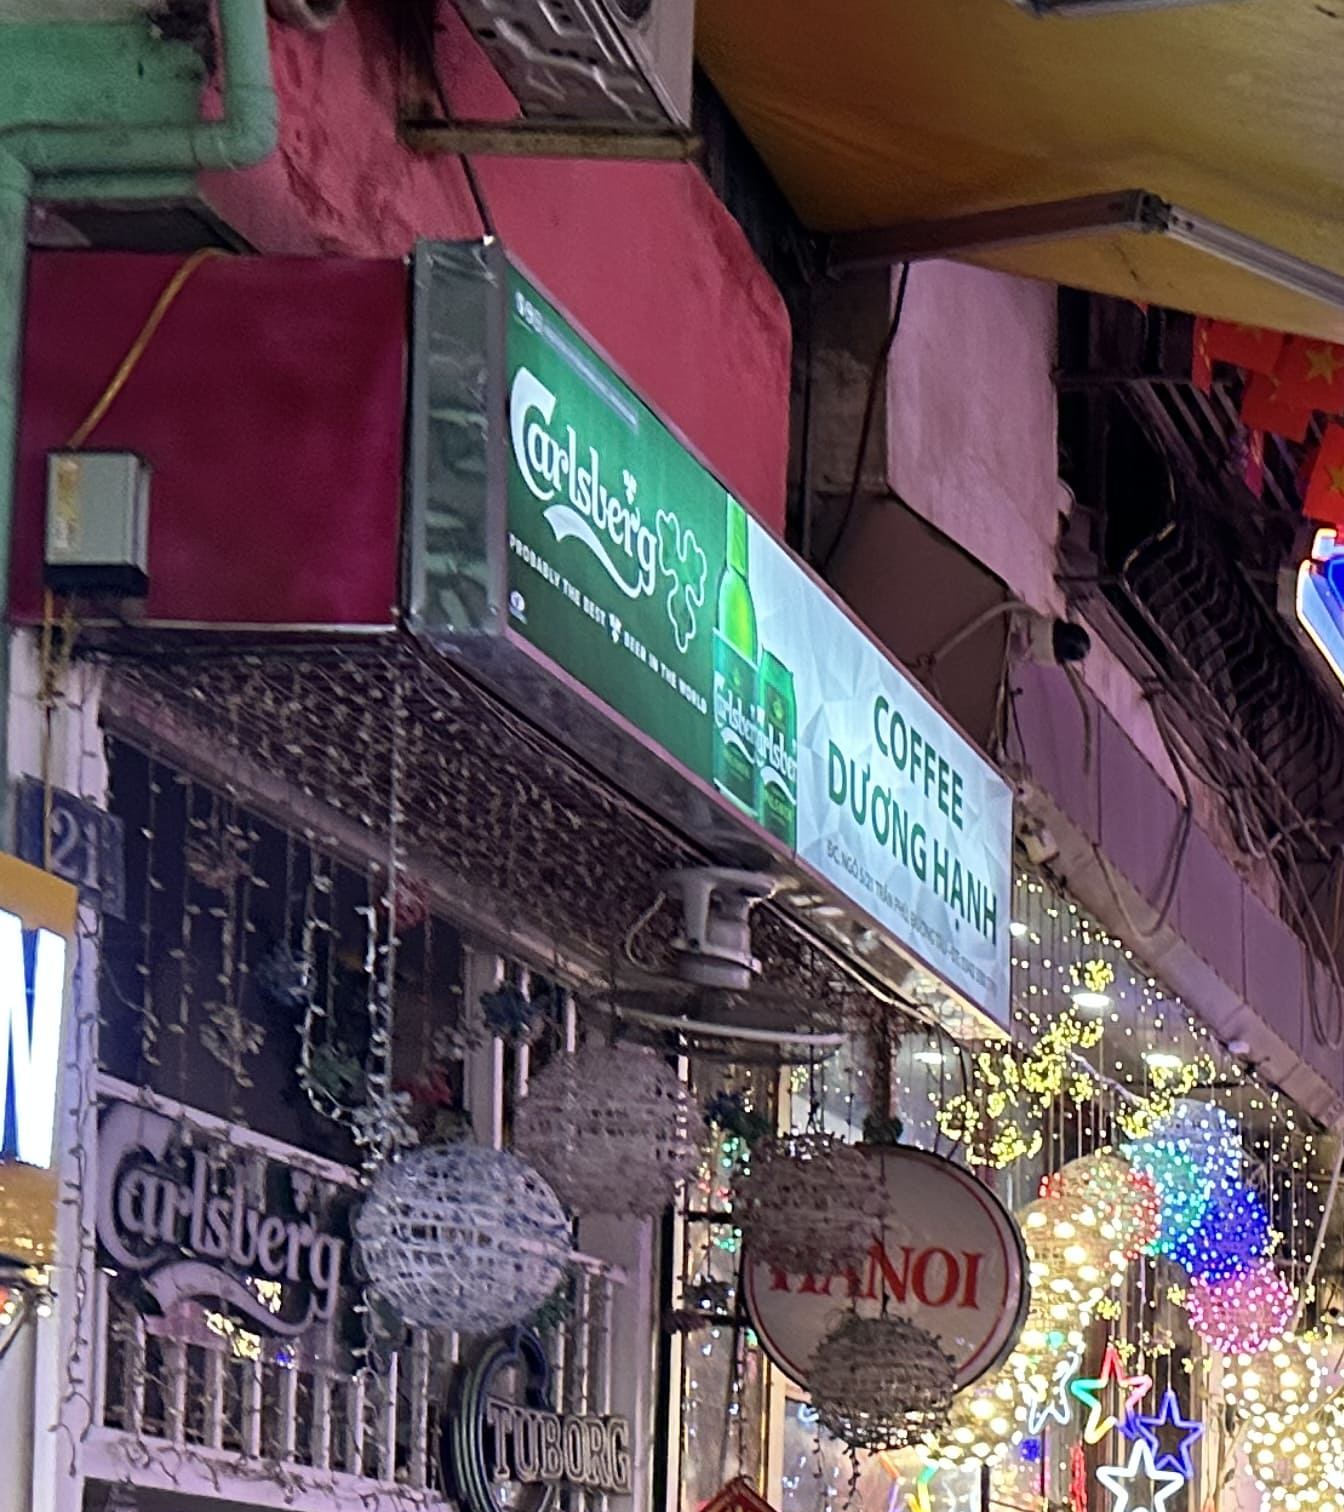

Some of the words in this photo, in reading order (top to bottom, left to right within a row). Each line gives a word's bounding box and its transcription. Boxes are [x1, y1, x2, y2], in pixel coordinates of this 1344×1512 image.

[510, 366, 658, 597] Carlsberg
[561, 577, 581, 608] THE
[828, 739, 927, 883] DƯƠNG
[933, 838, 996, 948] HẠNH
[873, 695, 964, 831] COFFEE
[95, 1101, 345, 1319] Carlsberg
[487, 1394, 632, 1496] TUBORG
